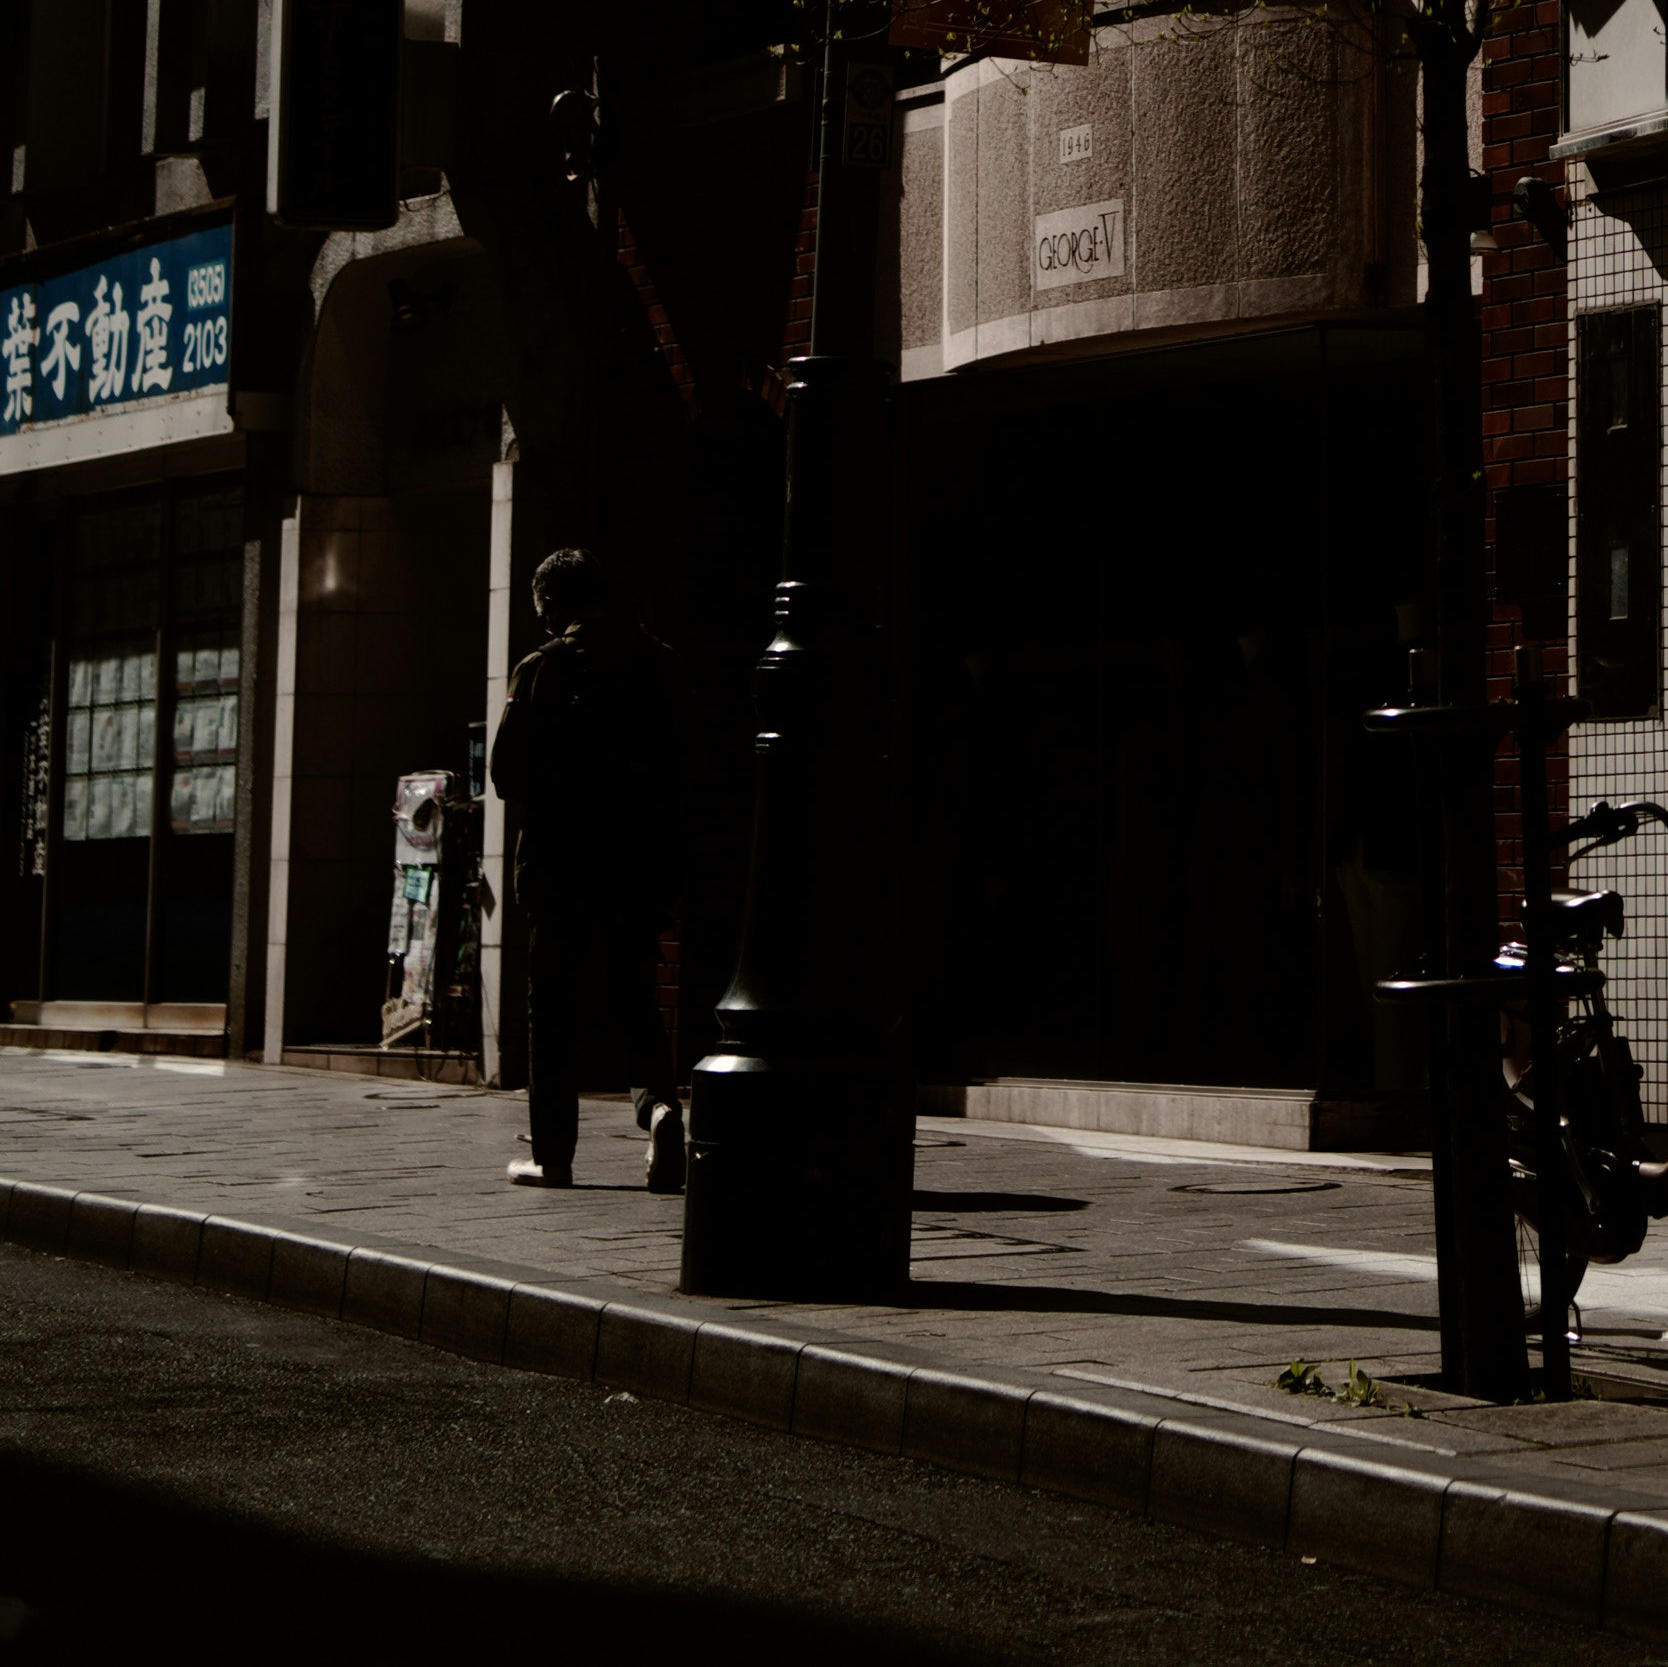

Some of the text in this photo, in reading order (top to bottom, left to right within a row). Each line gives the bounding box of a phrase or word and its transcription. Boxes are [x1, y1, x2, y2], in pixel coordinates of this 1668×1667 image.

[1062, 133, 1090, 156] 1946
[3, 257, 174, 423] 葉不動産
[182, 315, 228, 373] 2103
